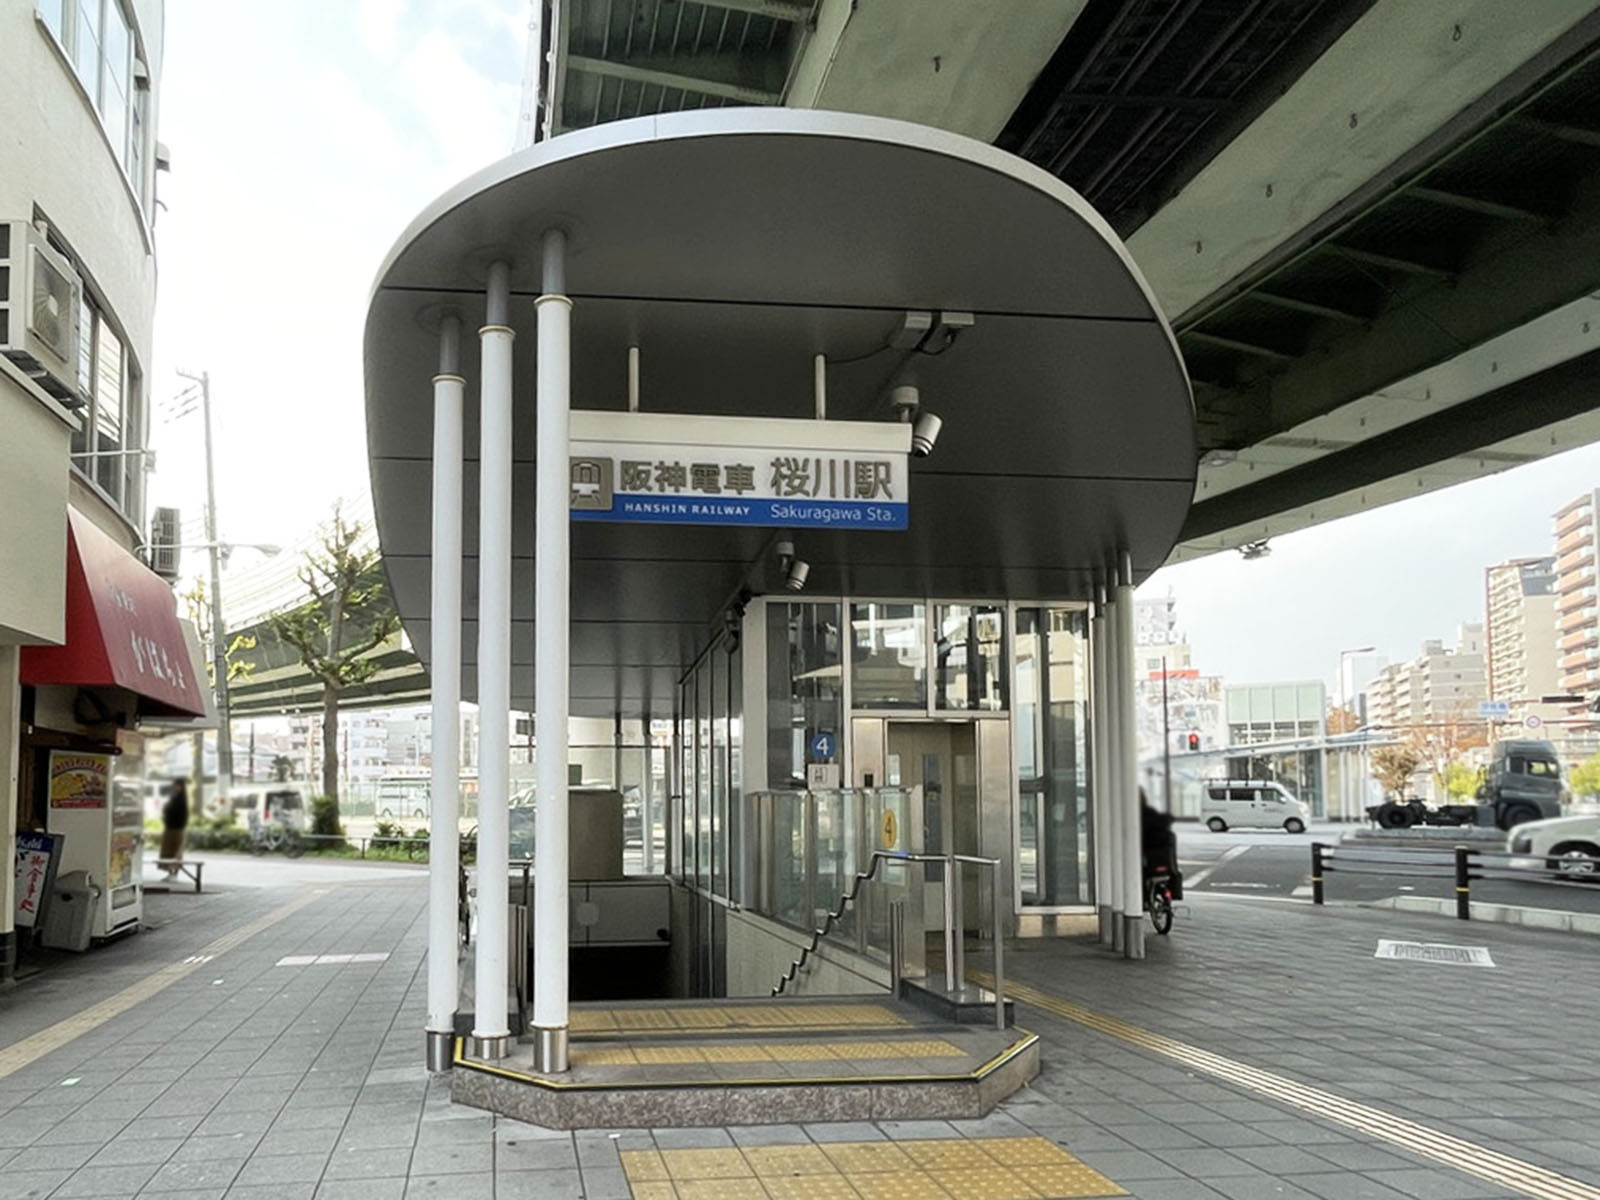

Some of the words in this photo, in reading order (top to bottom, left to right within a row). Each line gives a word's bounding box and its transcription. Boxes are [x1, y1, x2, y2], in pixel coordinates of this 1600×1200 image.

[619, 460, 756, 495] 阪神電車
[769, 457, 893, 499] 桜川駅
[624, 502, 687, 514] HANSHIN
[691, 504, 750, 516] RAILWAY
[770, 504, 862, 523] Sakuragawa
[866, 505, 897, 522] Sta.
[815, 736, 829, 756] 4
[884, 815, 893, 844] 4
